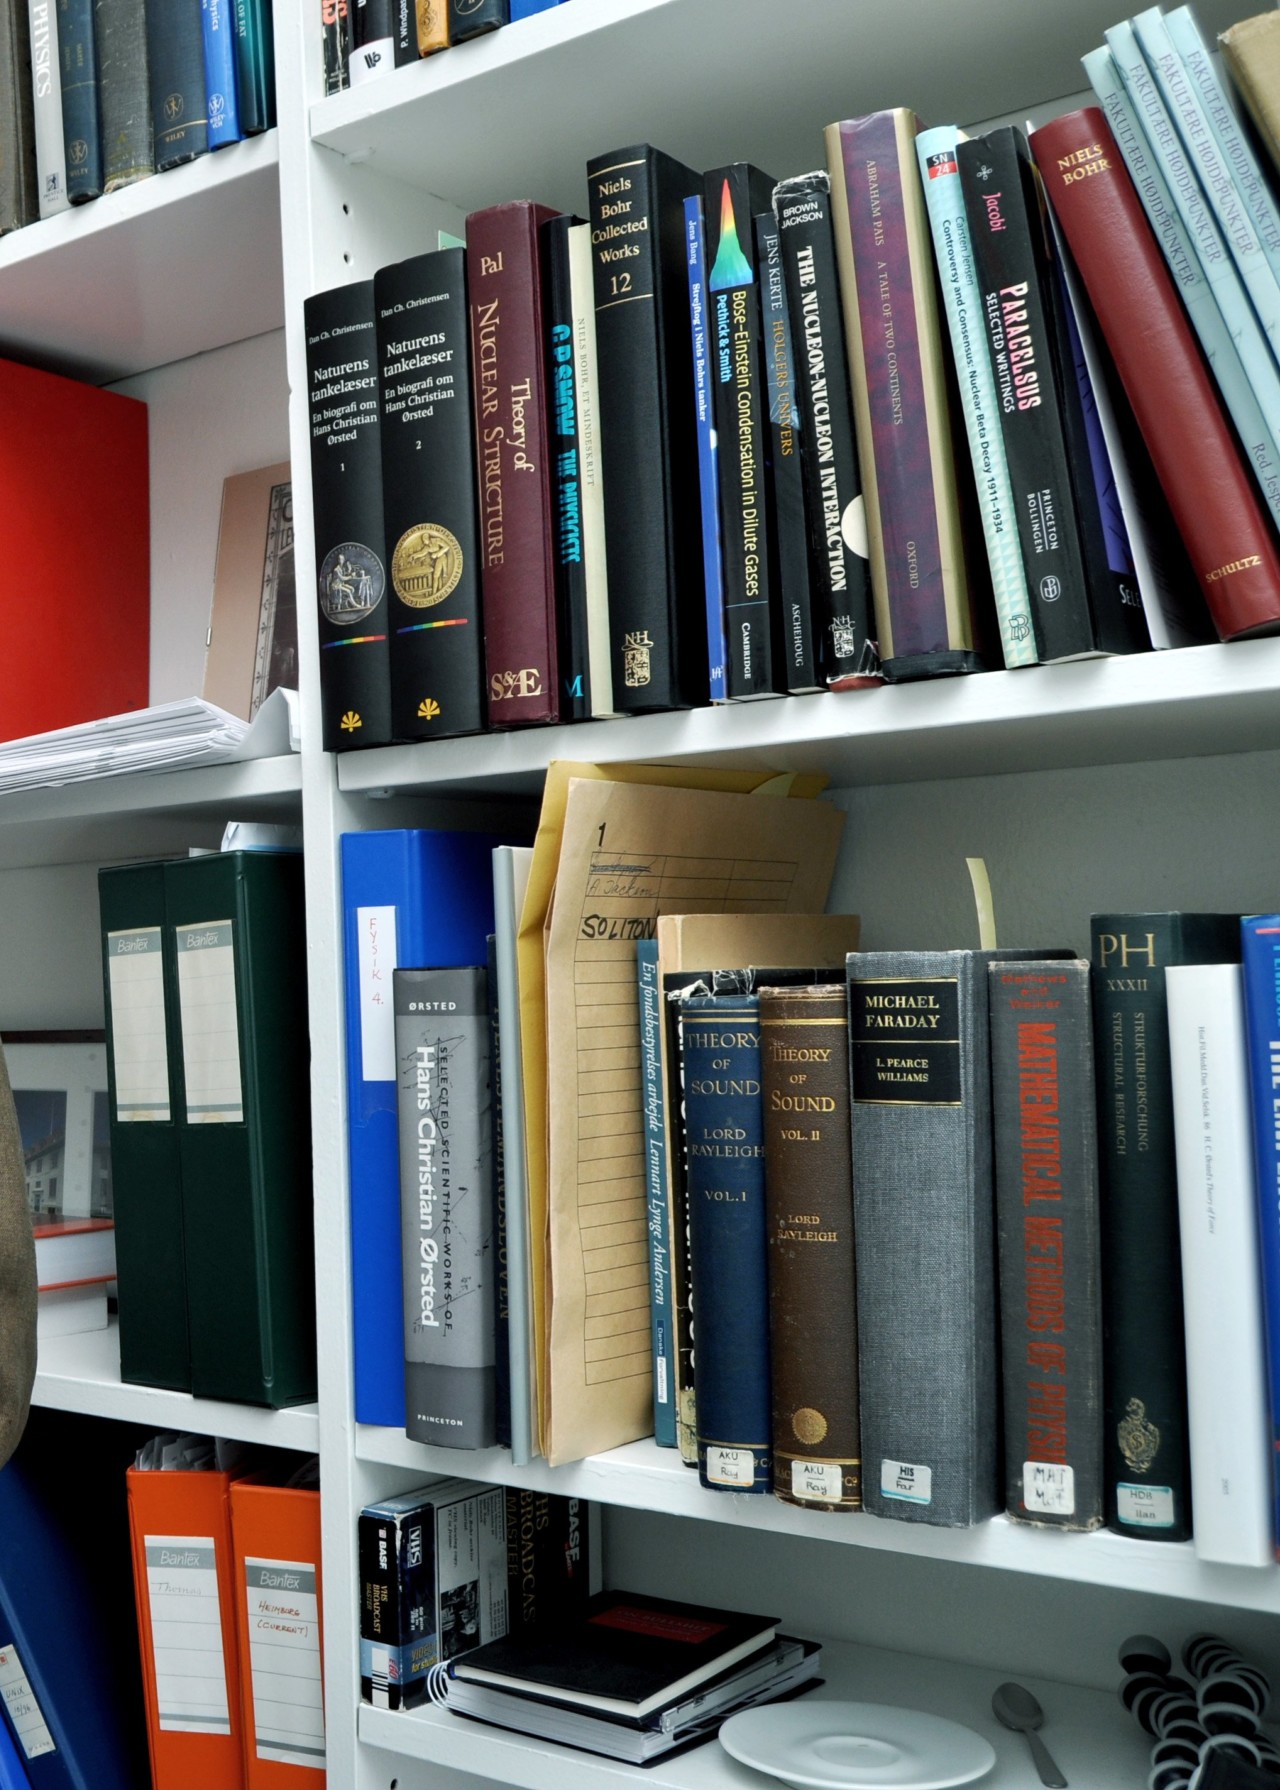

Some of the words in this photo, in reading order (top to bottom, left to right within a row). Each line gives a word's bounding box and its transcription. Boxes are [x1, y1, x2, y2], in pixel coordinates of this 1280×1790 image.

[34, 4, 50, 98] PHYSICS
[932, 154, 948, 165] SN
[936, 163, 950, 176] 24
[1057, 144, 1103, 171] NIELS
[1130, 64, 1174, 148] FAKULTÆRE
[1166, 149, 1221, 263] HØJDEPUNKTER
[1061, 158, 1112, 186] BOHR
[599, 177, 631, 197] Niels
[1105, 93, 1148, 176] FAKULTÆRE
[1141, 176, 1194, 286] HØJDEPUNKTER
[601, 198, 632, 219] Bohr
[781, 211, 823, 228] JACKSON
[783, 202, 818, 218] BROWN
[983, 192, 1006, 231] Jacobi
[592, 217, 648, 244] Collected
[481, 252, 503, 276] Pal
[600, 242, 640, 264] Works
[764, 235, 780, 265] JENS
[796, 246, 816, 287] THE
[610, 272, 632, 296] 12
[768, 268, 782, 311] KERTE
[717, 294, 729, 337] Pethick
[387, 332, 446, 357] Naturens
[719, 339, 729, 348] &
[773, 320, 788, 388] HOLGERS
[986, 293, 1004, 349] SELECTED
[996, 351, 1014, 413] WRITINGS
[1000, 281, 1041, 411] PARACELSUS
[314, 359, 369, 382] Naturens
[384, 349, 453, 377] tankelæser
[478, 298, 500, 418] NUCLEAR
[719, 349, 731, 383] Smith
[312, 376, 377, 402] tankelæser
[385, 389, 395, 399] En
[398, 378, 433, 397] biografi
[436, 375, 453, 386] om
[802, 290, 834, 463] NUCLEON-NUCLEON
[385, 399, 406, 413] Hans
[408, 388, 454, 406] Christian
[402, 406, 433, 422] Ørsted
[778, 392, 792, 456] UNIVERS
[737, 392, 755, 486] Condensation
[484, 427, 504, 566] STRUCTURE
[742, 492, 756, 505] in
[742, 508, 758, 551] Dilute
[821, 467, 846, 592] INTERACTION
[745, 554, 758, 597] Gases
[906, 541, 918, 589] OXFORD
[1206, 555, 1262, 582] SCHULTZ
[742, 622, 751, 679] CAMBRIDGE
[582, 912, 659, 940] SOLITON
[1100, 933, 1155, 968] PH
[1107, 979, 1147, 990] XXXII
[409, 1001, 456, 1012] ØRSTED
[866, 996, 939, 1008] MICHAEL
[866, 1015, 940, 1028] FARADAY
[686, 1033, 761, 1048] THEORY
[416, 1046, 435, 1110] Hans
[713, 1059, 731, 1069] OF
[878, 1072, 929, 1082] WILLIAMS
[440, 1046, 449, 1130] SELECTED
[691, 1080, 760, 1095] SOUND
[1018, 1023, 1062, 1206] MATHEMATICAL
[704, 1129, 746, 1140] LORD
[691, 1145, 765, 1157] RAYLEIGH
[418, 1117, 437, 1231] Christian
[441, 1138, 450, 1236] SCIENTIFIC
[420, 1238, 439, 1327] Ørsted
[443, 1242, 452, 1301] WORKS
[1023, 1216, 1065, 1332] METHODS
[444, 1310, 453, 1331] OF
[1026, 1340, 1065, 1373] OF
[418, 1413, 463, 1426] PRINCETON
[161, 1550, 201, 1566] Bantex
[379, 1540, 387, 1569] BASF
[411, 1530, 420, 1564] VHS
[260, 1572, 300, 1589] Bantex
